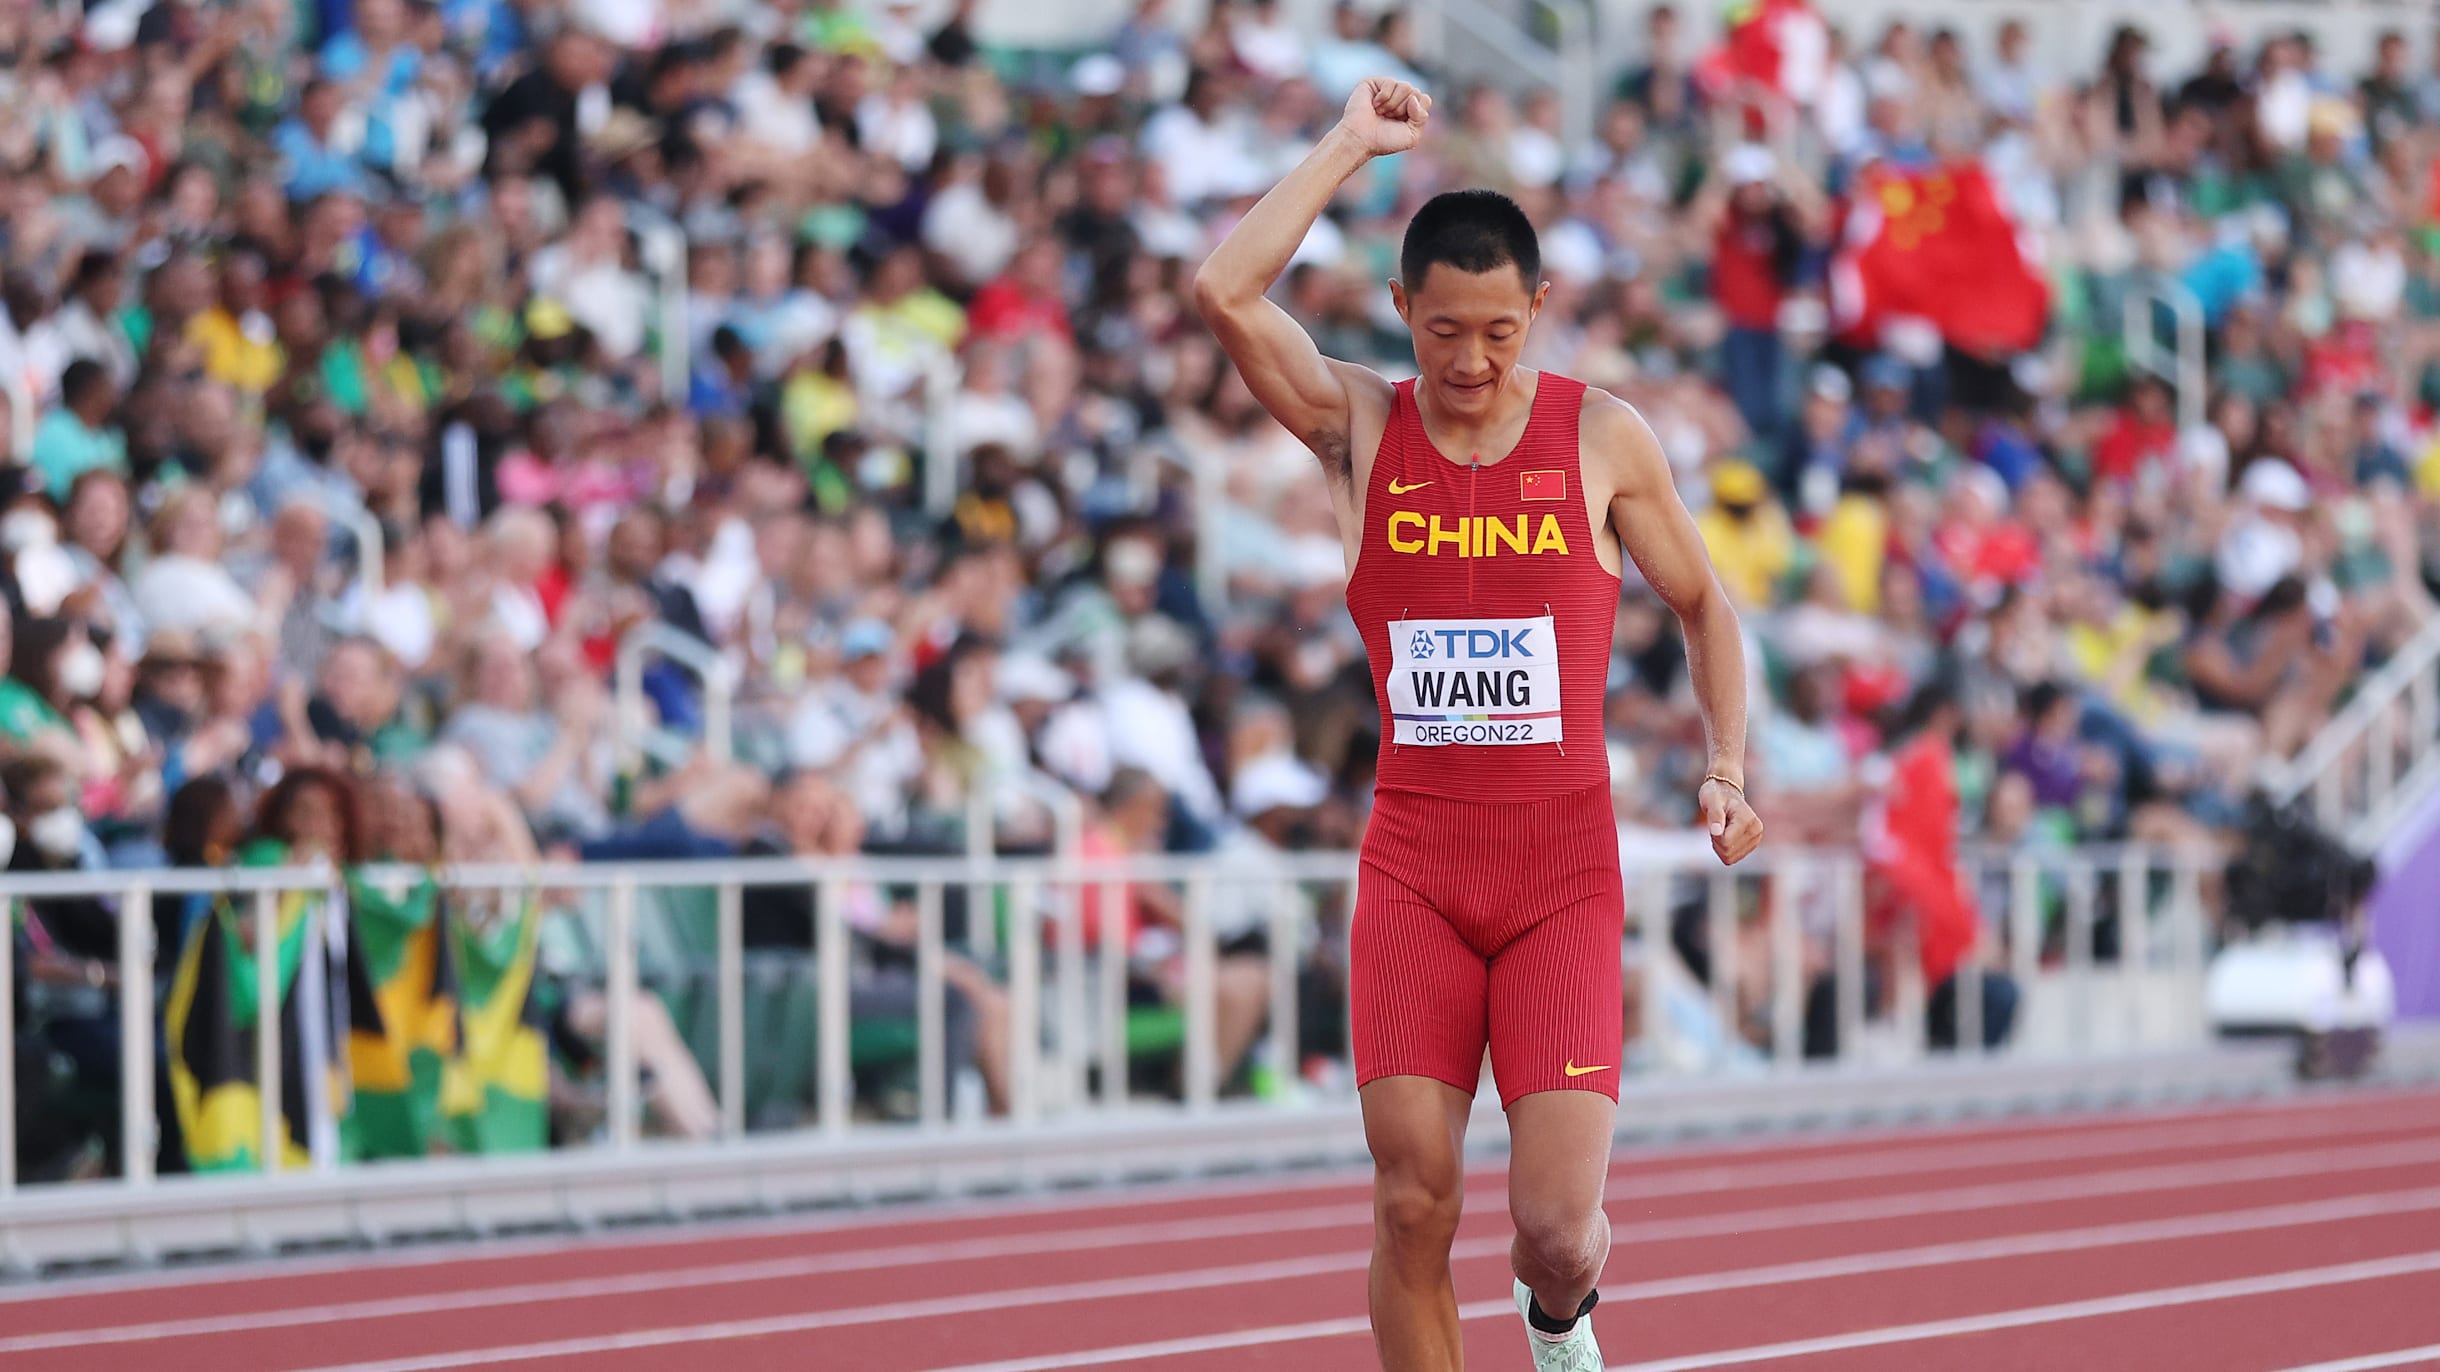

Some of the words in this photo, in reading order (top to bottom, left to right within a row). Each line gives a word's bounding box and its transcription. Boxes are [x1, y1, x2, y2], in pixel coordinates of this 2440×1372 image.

[1388, 510, 1569, 557] CHINA
[1435, 628, 1534, 658] TDK
[1412, 670, 1530, 707] WANG
[1415, 724, 1533, 743] OREGON22
